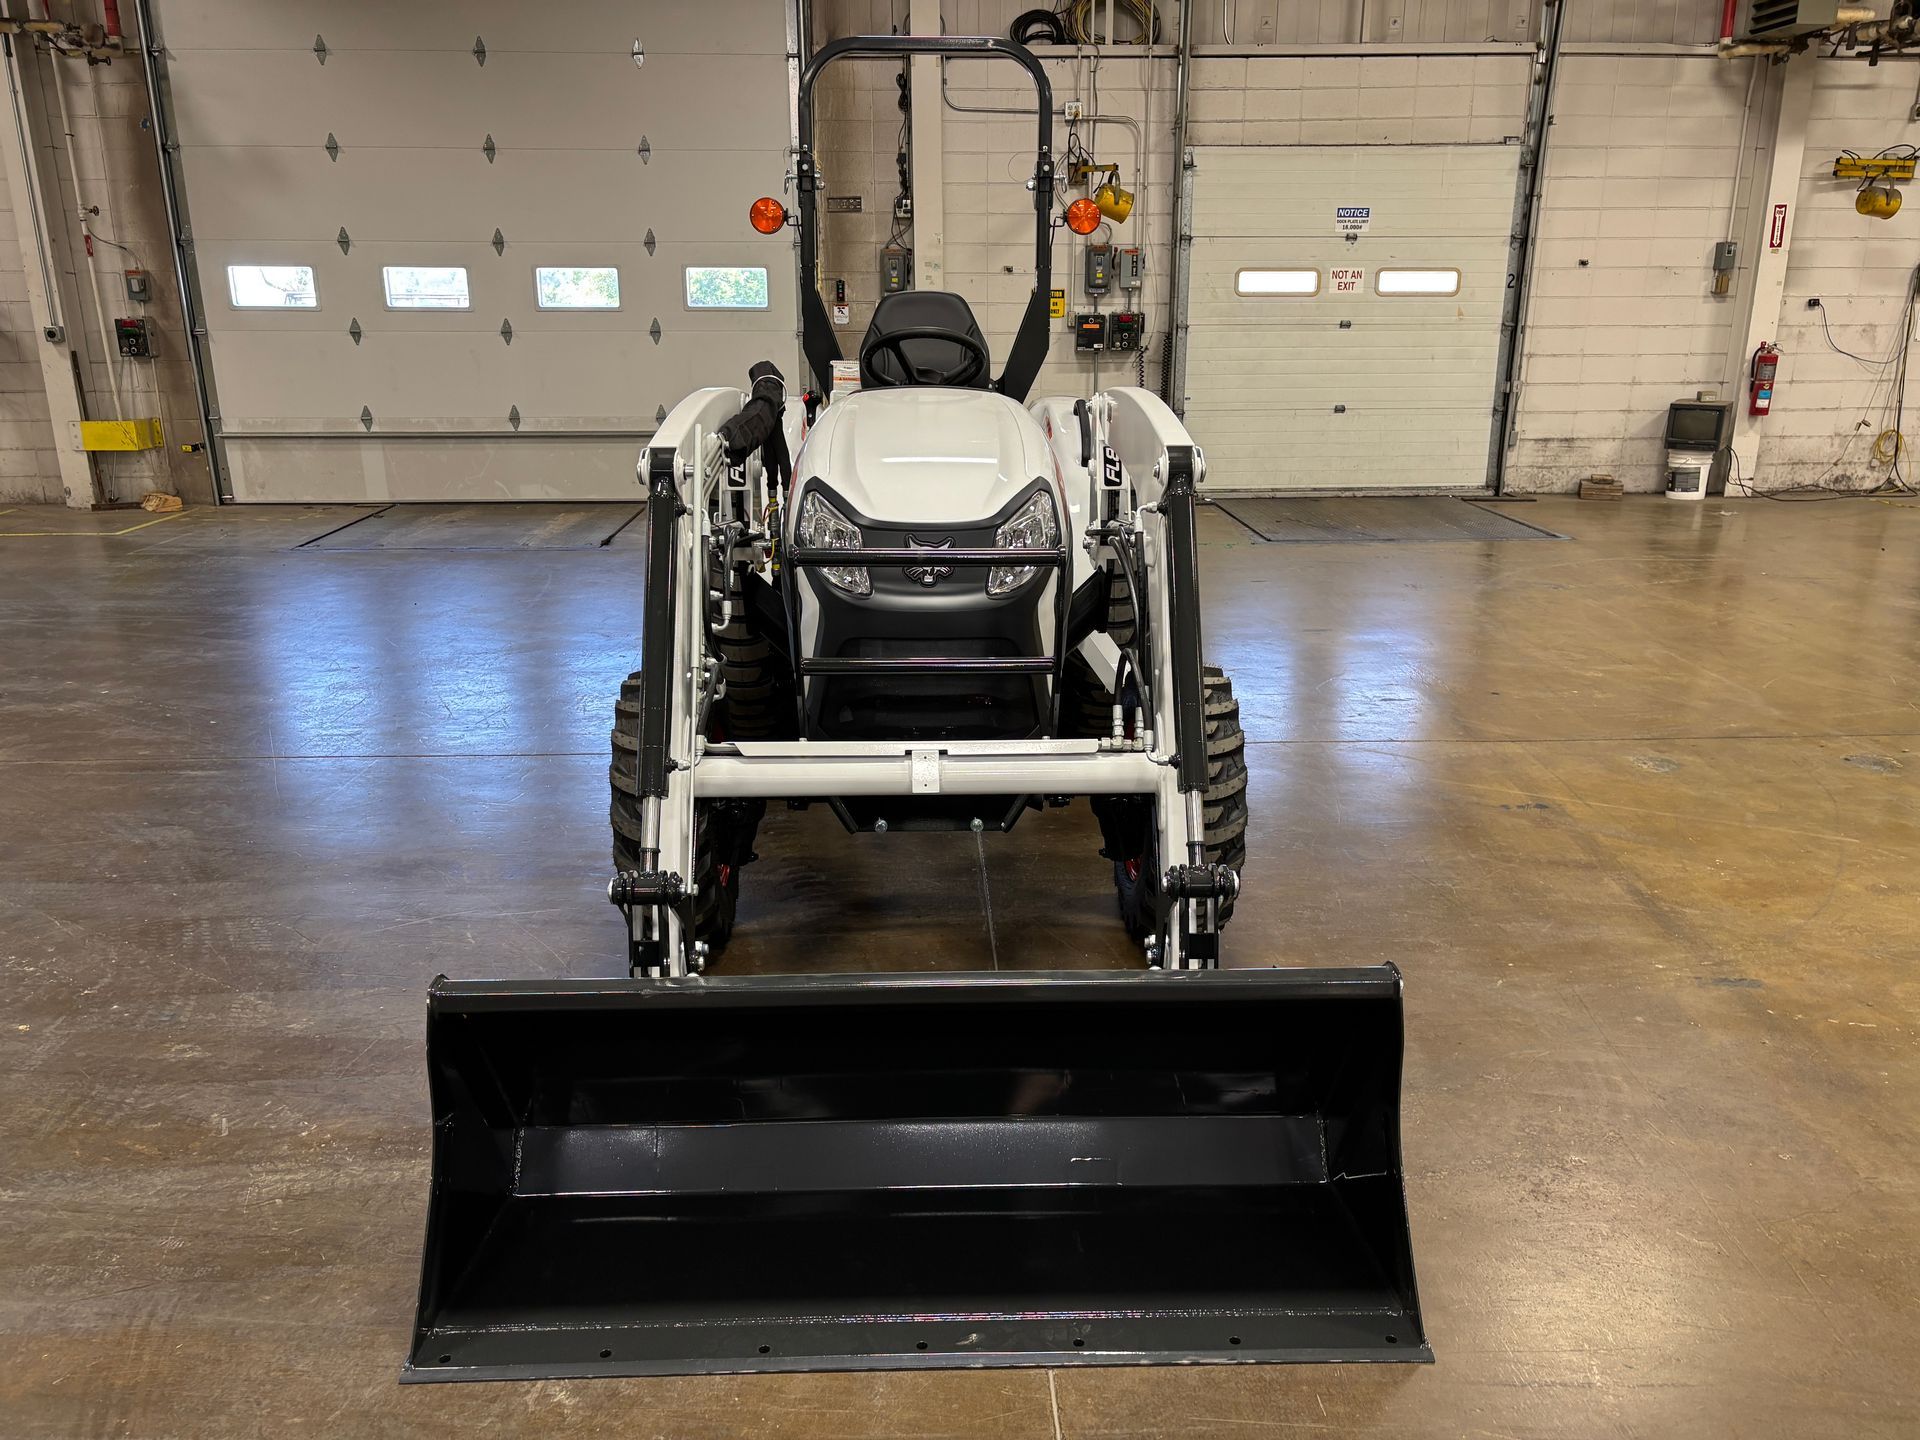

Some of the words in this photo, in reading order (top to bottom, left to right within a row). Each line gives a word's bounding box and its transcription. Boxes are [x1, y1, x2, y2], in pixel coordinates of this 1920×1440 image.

[1338, 208, 1369, 217] NOTICE
[1331, 270, 1349, 279] NOT
[1350, 270, 1363, 279] AN
[1507, 273, 1515, 288] 2
[1337, 281, 1356, 291] EXIT
[730, 463, 745, 484] FL
